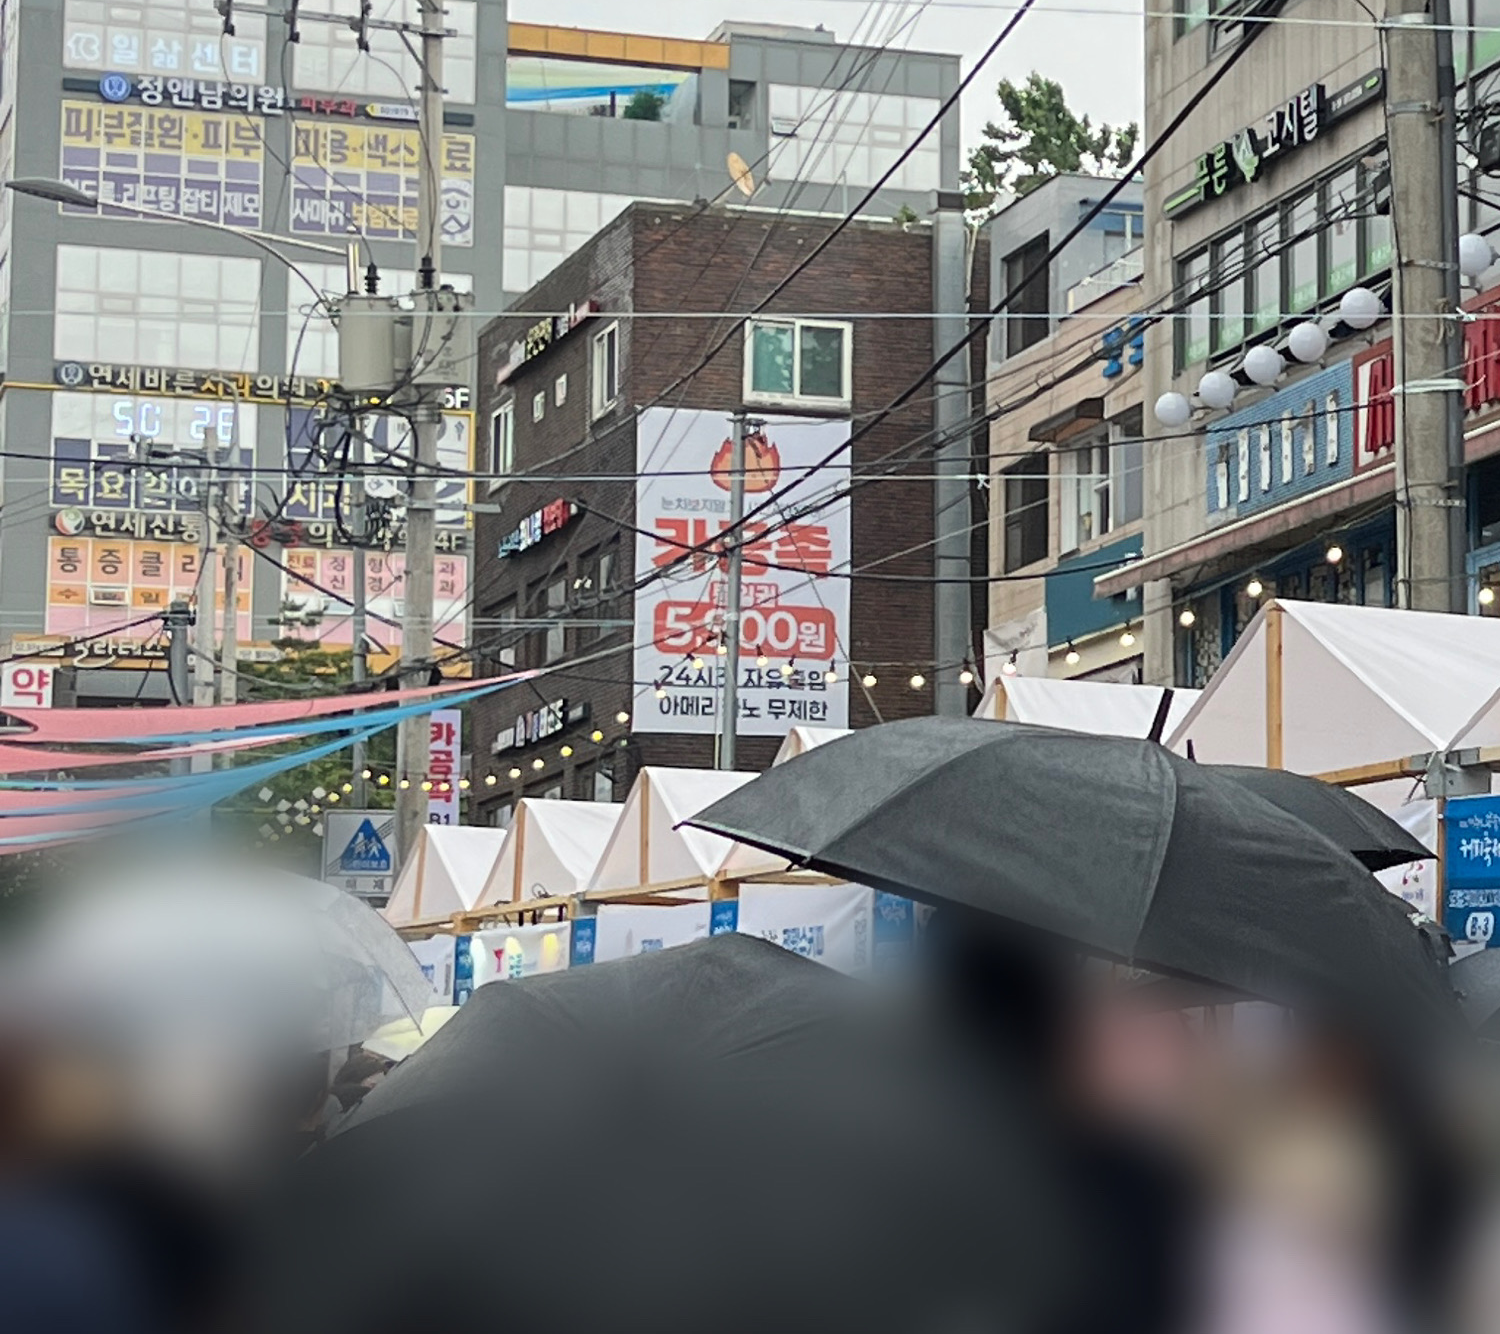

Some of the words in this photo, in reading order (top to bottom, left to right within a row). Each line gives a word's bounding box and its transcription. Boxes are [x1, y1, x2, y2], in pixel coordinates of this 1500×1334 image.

[1262, 83, 1318, 158] 고시텔
[12, 669, 50, 706] 약
[767, 698, 828, 721] 무제한
